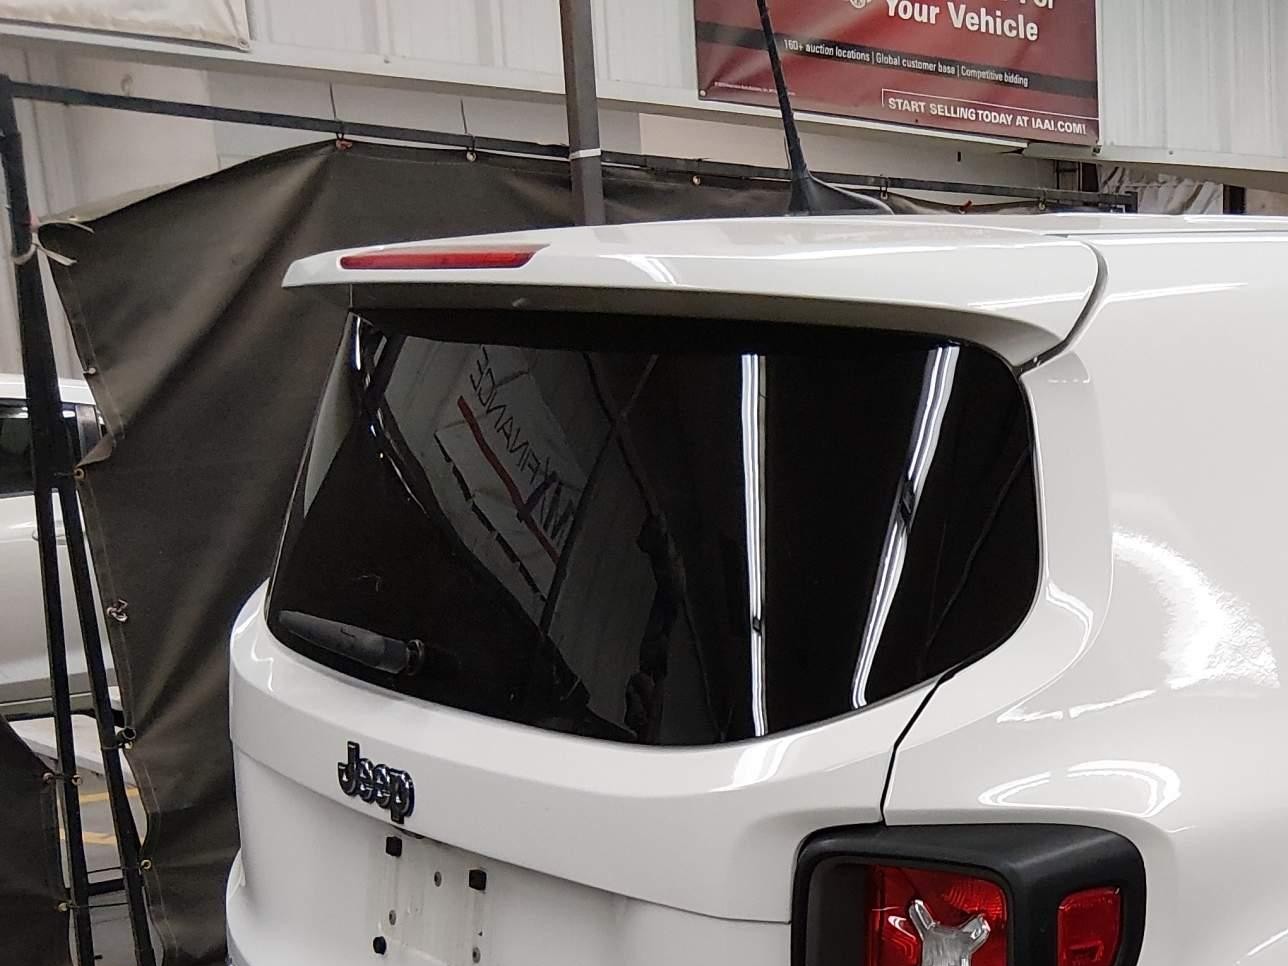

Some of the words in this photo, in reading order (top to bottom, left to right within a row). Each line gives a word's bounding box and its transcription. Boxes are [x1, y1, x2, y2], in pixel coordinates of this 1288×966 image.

[886, 0, 940, 24] Your
[947, 1, 1038, 41] Vehicle
[805, 43, 834, 56] auction
[835, 46, 870, 62] locations
[876, 52, 900, 66] Global
[902, 58, 936, 72] customer
[938, 62, 955, 75] base
[961, 65, 1003, 81] Competitive
[1004, 72, 1028, 87] bidding
[888, 97, 925, 113] START
[929, 104, 976, 121] SELLING
[976, 110, 1013, 126] TODAY
[1015, 116, 1030, 128] AT
[1031, 117, 1087, 135] IAAI.COM!
[337, 740, 415, 824] Jeep
